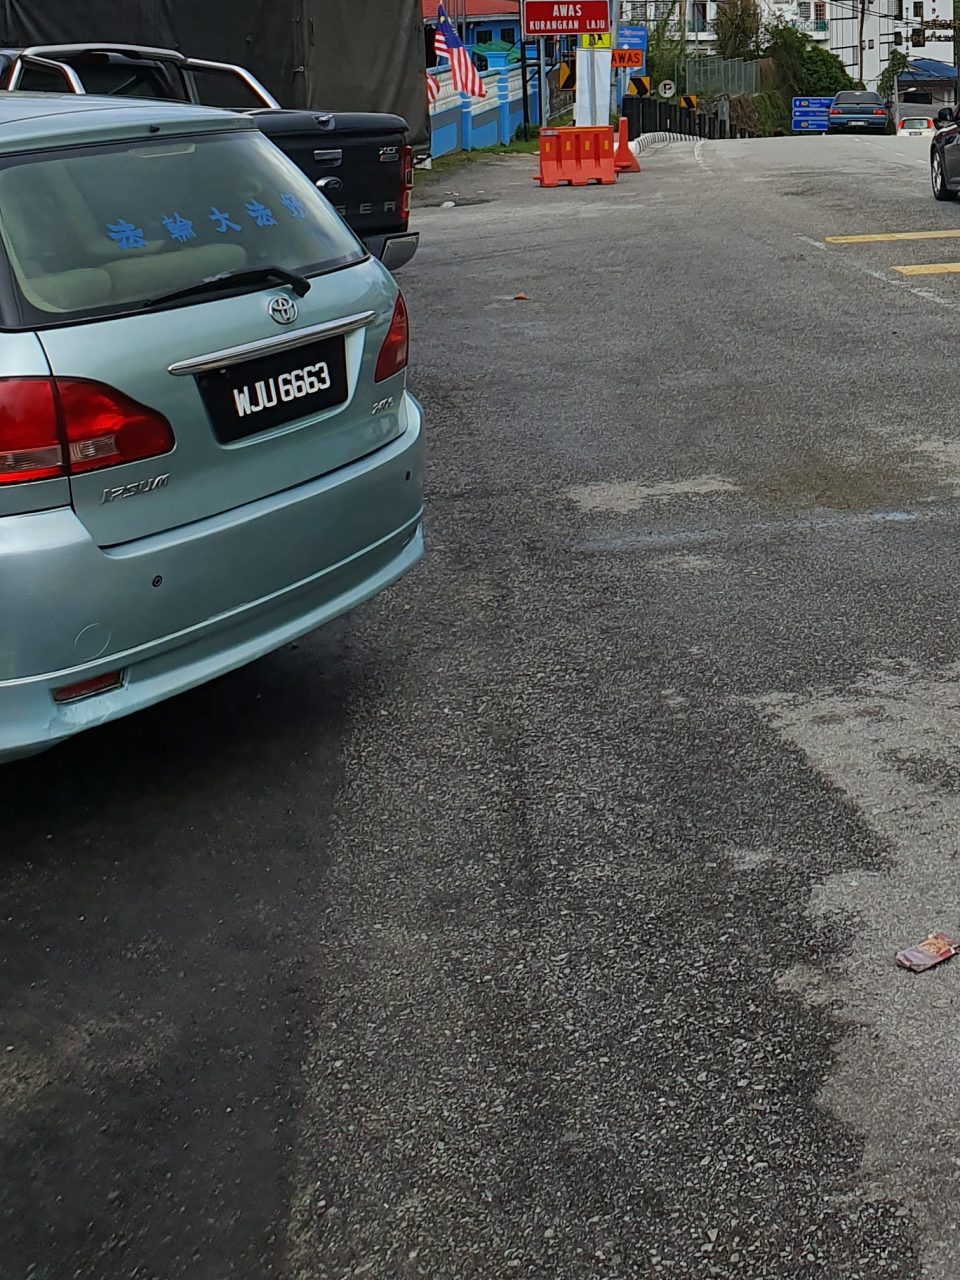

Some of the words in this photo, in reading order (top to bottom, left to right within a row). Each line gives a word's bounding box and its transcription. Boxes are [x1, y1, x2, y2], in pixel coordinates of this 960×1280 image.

[552, 4, 582, 17] AWAS
[529, 20, 579, 30] KURANGKAN
[586, 19, 605, 29] LAJU
[611, 52, 641, 64] AWAS
[99, 472, 171, 505] IPSUM
